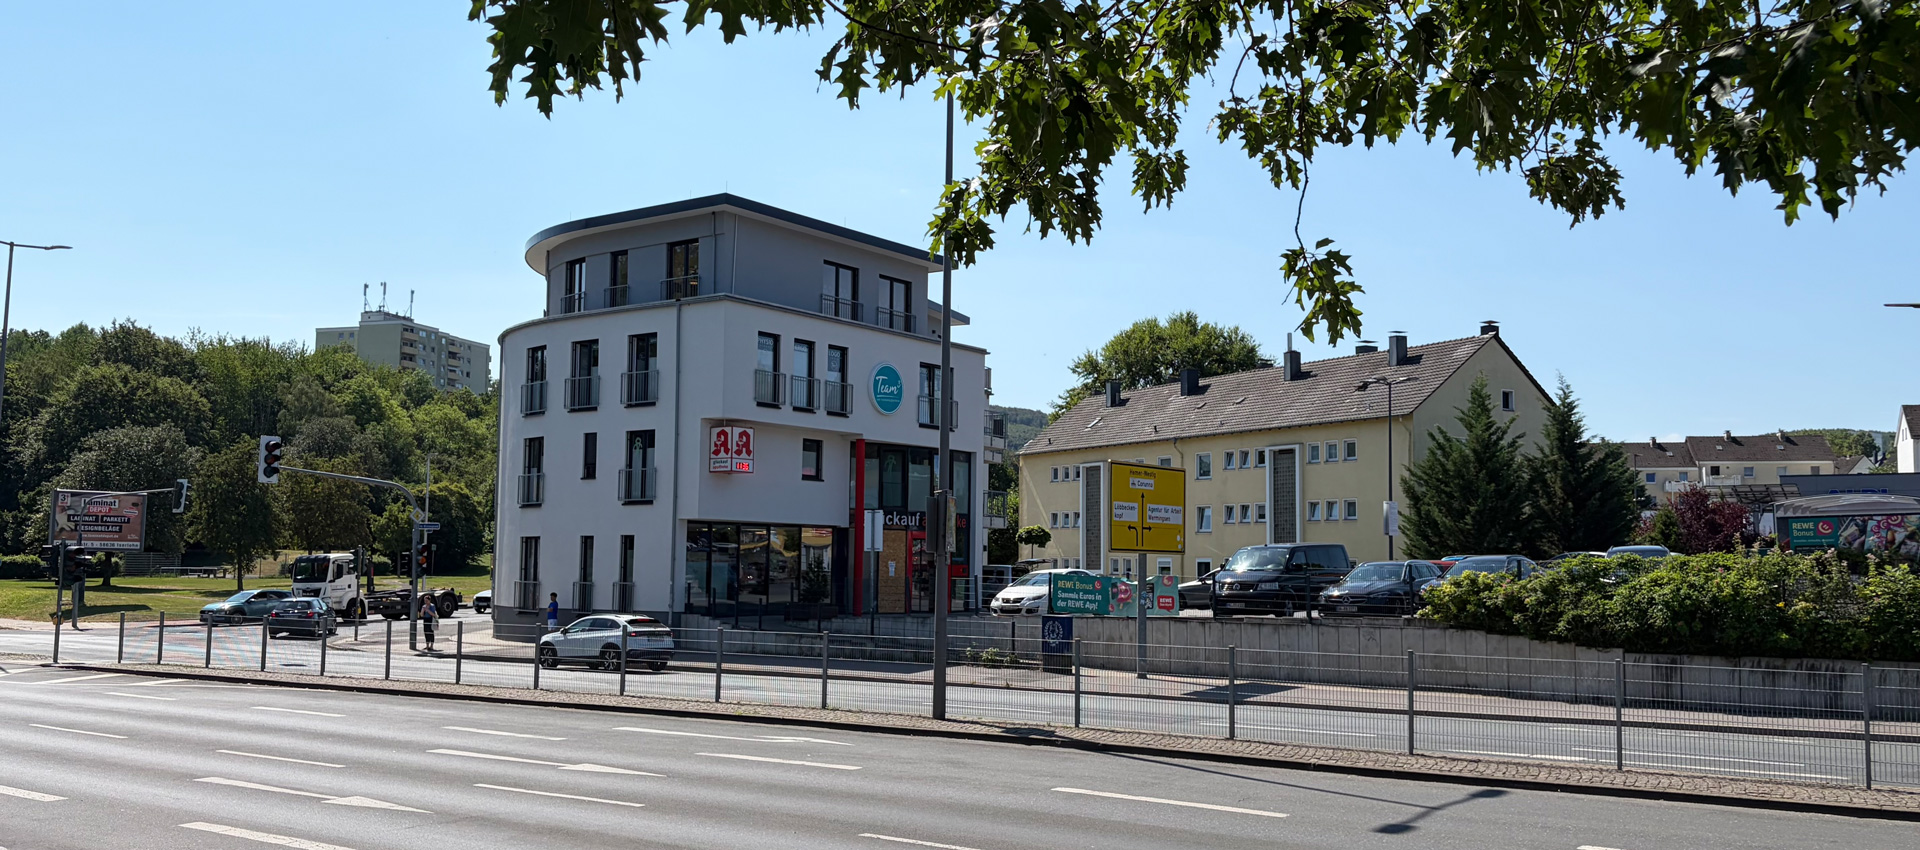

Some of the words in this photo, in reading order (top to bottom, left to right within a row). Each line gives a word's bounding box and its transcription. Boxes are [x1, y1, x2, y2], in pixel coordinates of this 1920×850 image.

[1148, 506, 1162, 514] Agentur
[1058, 580, 1074, 589] REWE
[1076, 581, 1093, 590] Bonus
[1057, 591, 1078, 599] Sammle
[1085, 602, 1098, 610] App!
